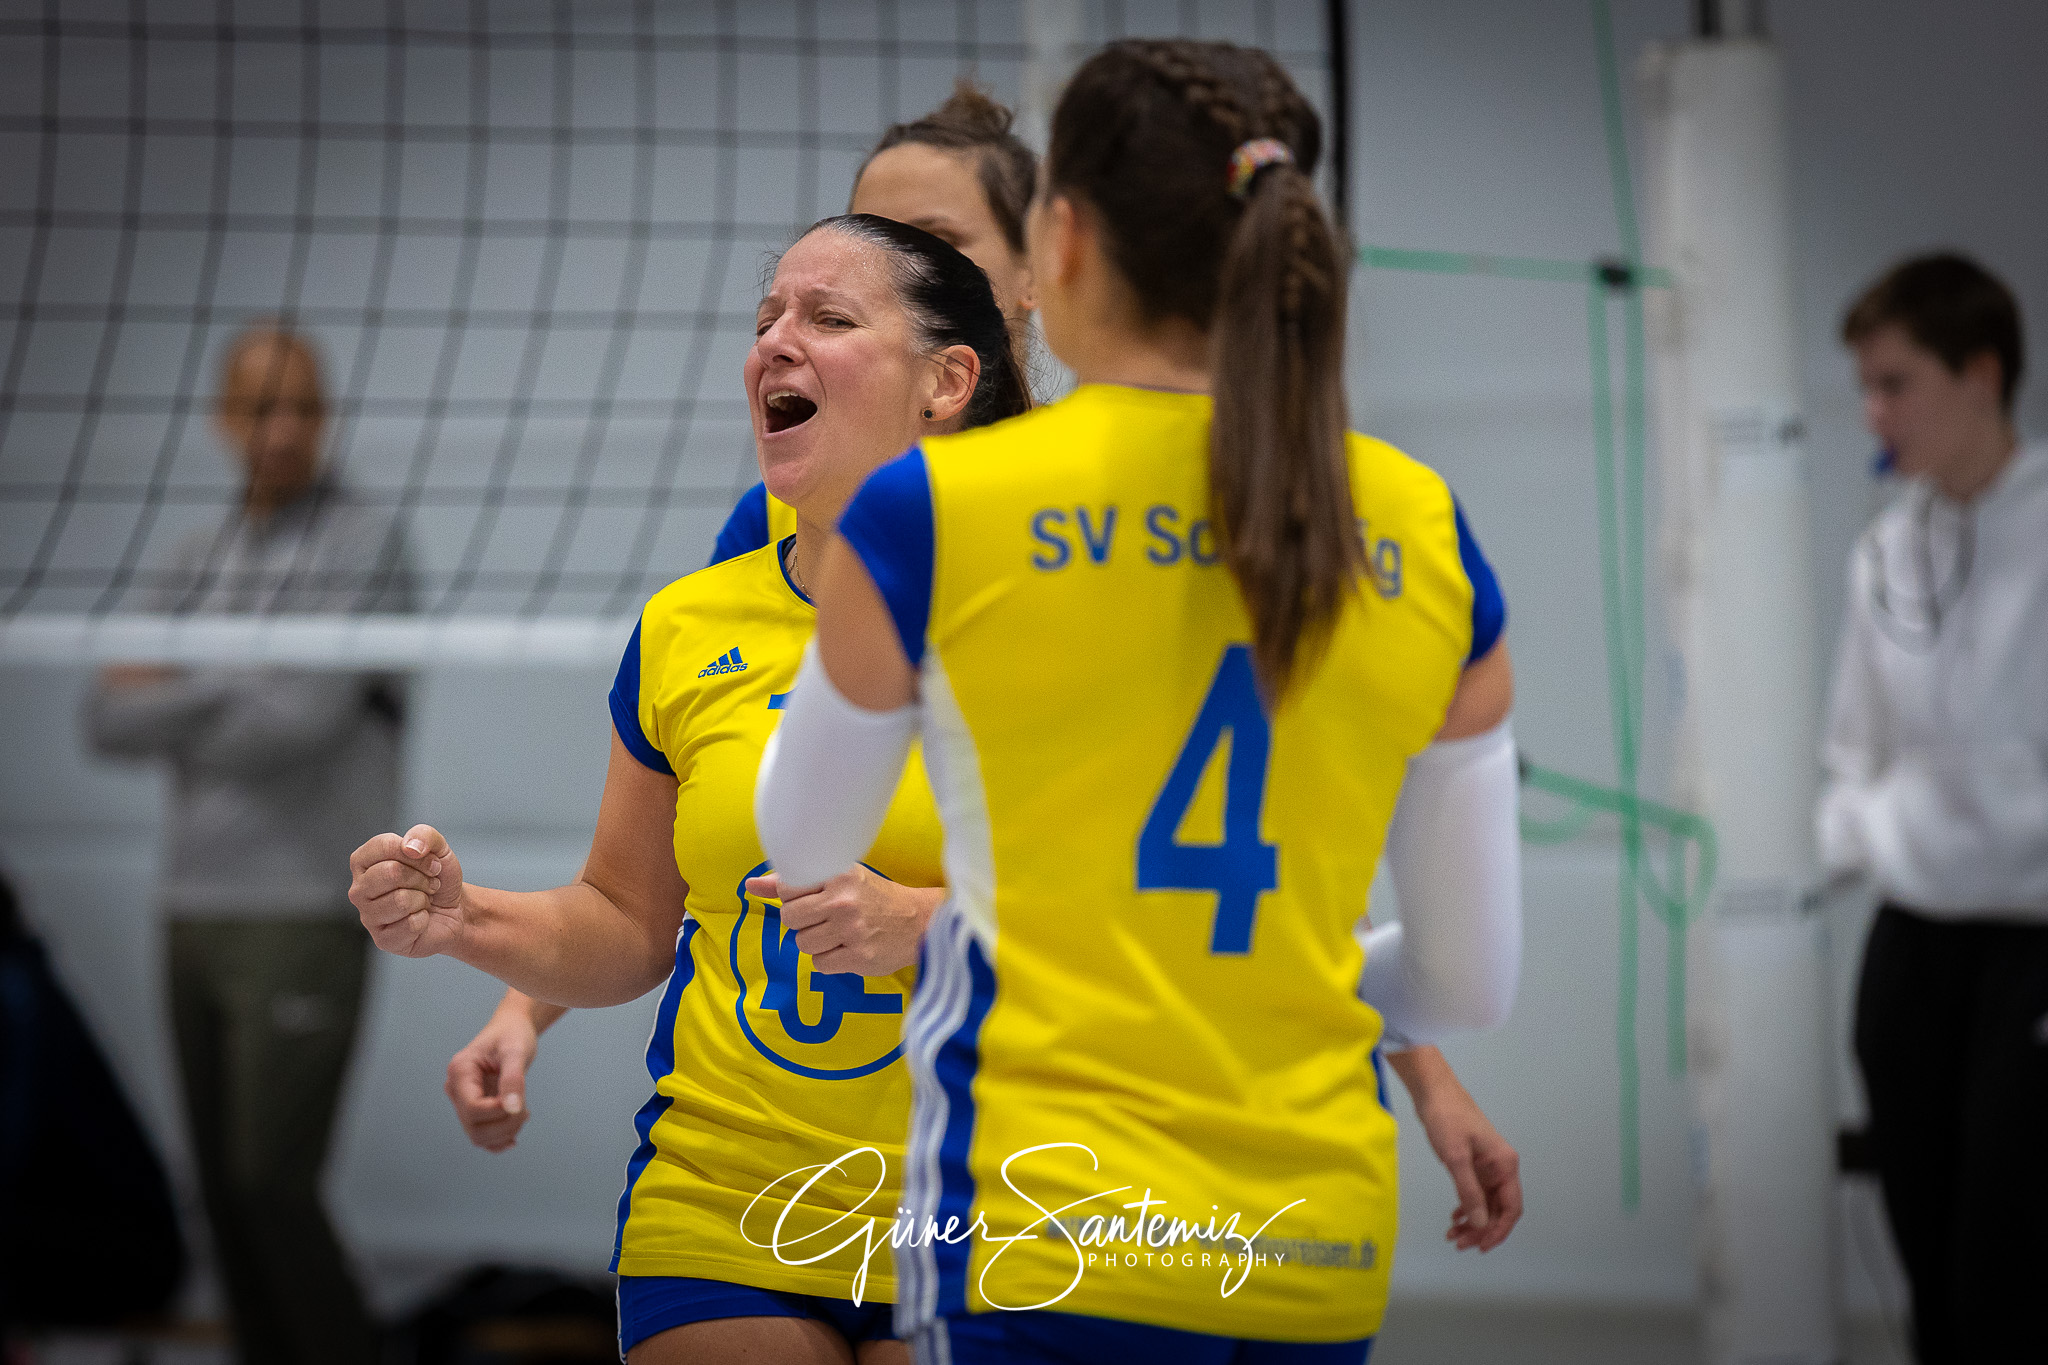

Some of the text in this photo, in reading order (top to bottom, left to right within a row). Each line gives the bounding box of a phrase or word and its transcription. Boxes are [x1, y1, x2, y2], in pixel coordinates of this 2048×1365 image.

[1029, 506, 1118, 571] SV
[697, 662, 749, 679] adidas
[1135, 643, 1280, 956] 4
